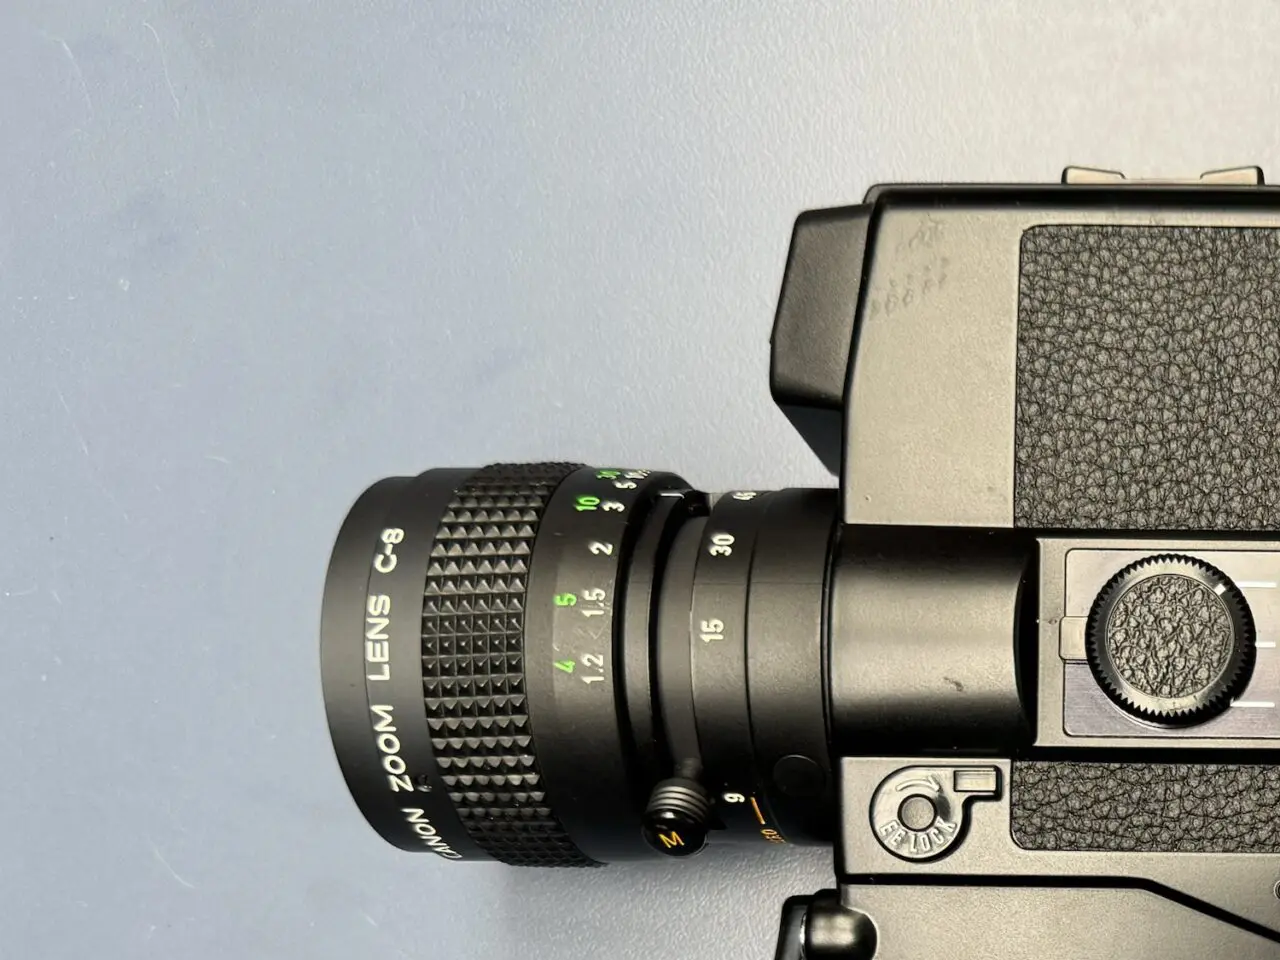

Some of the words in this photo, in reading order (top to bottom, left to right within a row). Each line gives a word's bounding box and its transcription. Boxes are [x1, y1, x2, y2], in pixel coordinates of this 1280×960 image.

[575, 496, 600, 511] 10
[601, 501, 625, 512] 3
[373, 527, 405, 574] C-8
[589, 541, 613, 555] 2
[709, 533, 735, 556] 30
[554, 592, 577, 606] 5
[582, 588, 606, 618] 1.5
[365, 594, 391, 681] LENS
[700, 619, 724, 642] 15
[553, 659, 576, 673] 4
[582, 654, 605, 684] 1.2
[370, 704, 414, 792] ZOOM
[400, 808, 463, 859] CANON
[658, 831, 685, 848] M
[880, 819, 906, 846] EE
[908, 816, 957, 852] LOCK
